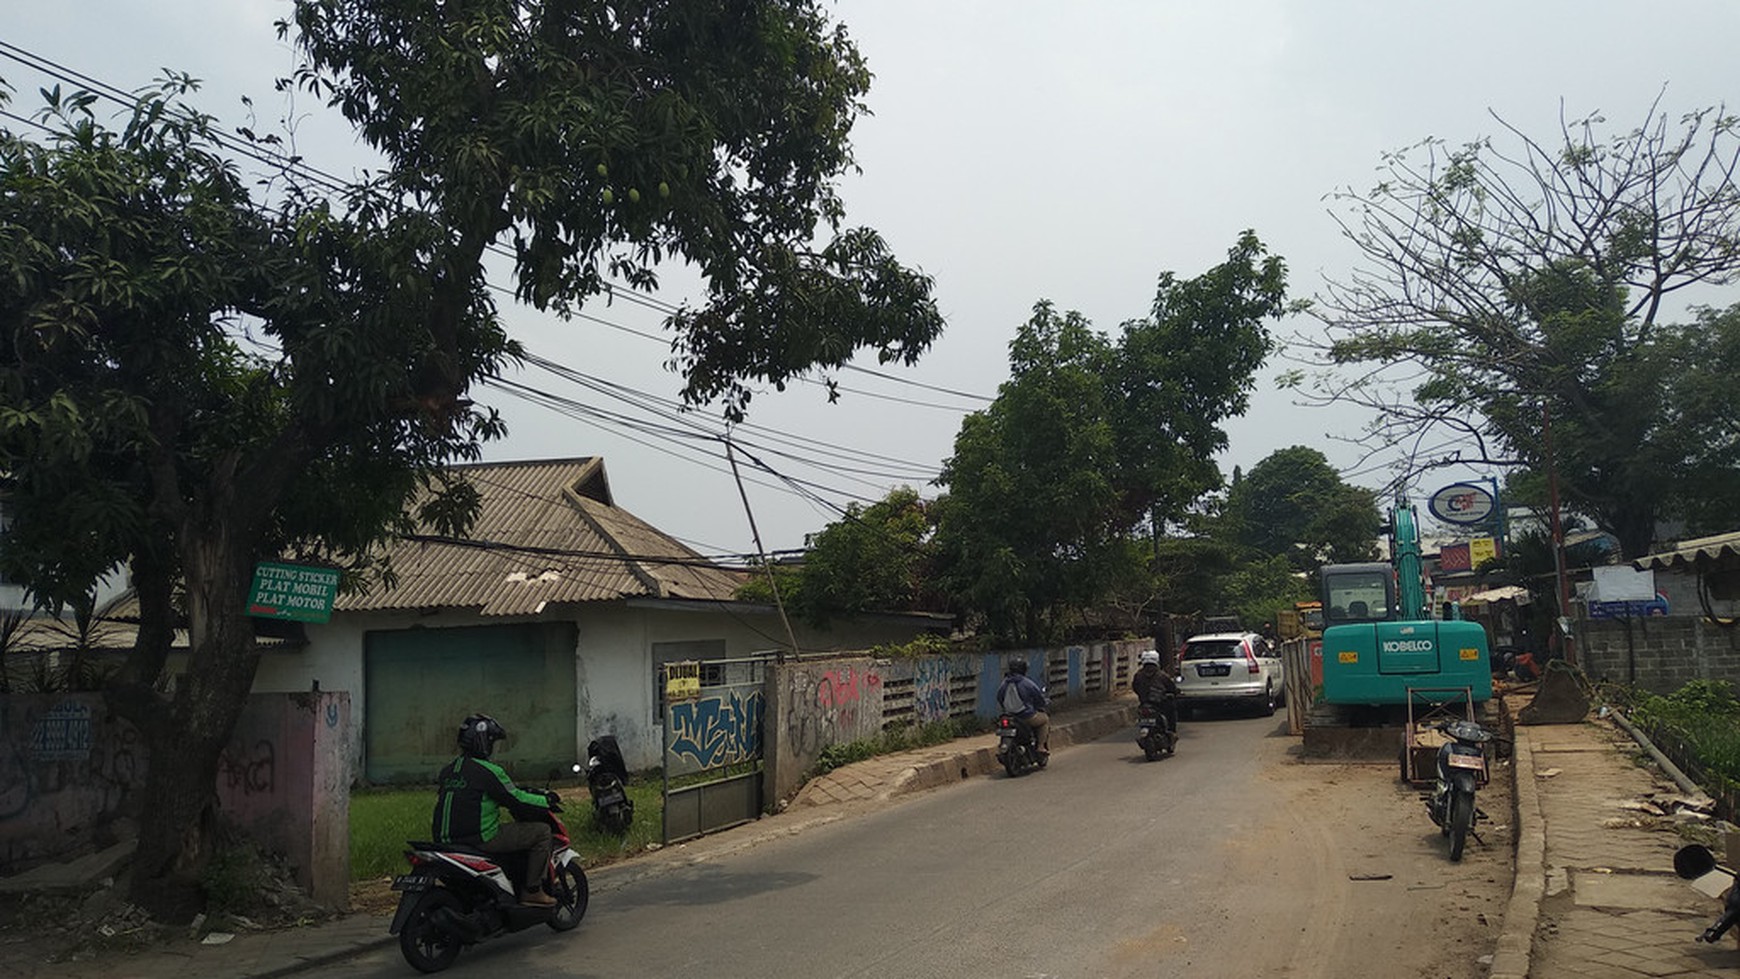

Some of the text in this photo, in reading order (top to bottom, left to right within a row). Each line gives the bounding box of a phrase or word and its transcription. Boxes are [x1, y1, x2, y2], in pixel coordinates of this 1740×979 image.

[256, 567, 337, 585] CUTTING STICKER
[260, 579, 328, 596] PLAT MOBIL
[256, 592, 325, 610] PLAT MOTOR
[1383, 640, 1433, 652] KOBELCO
